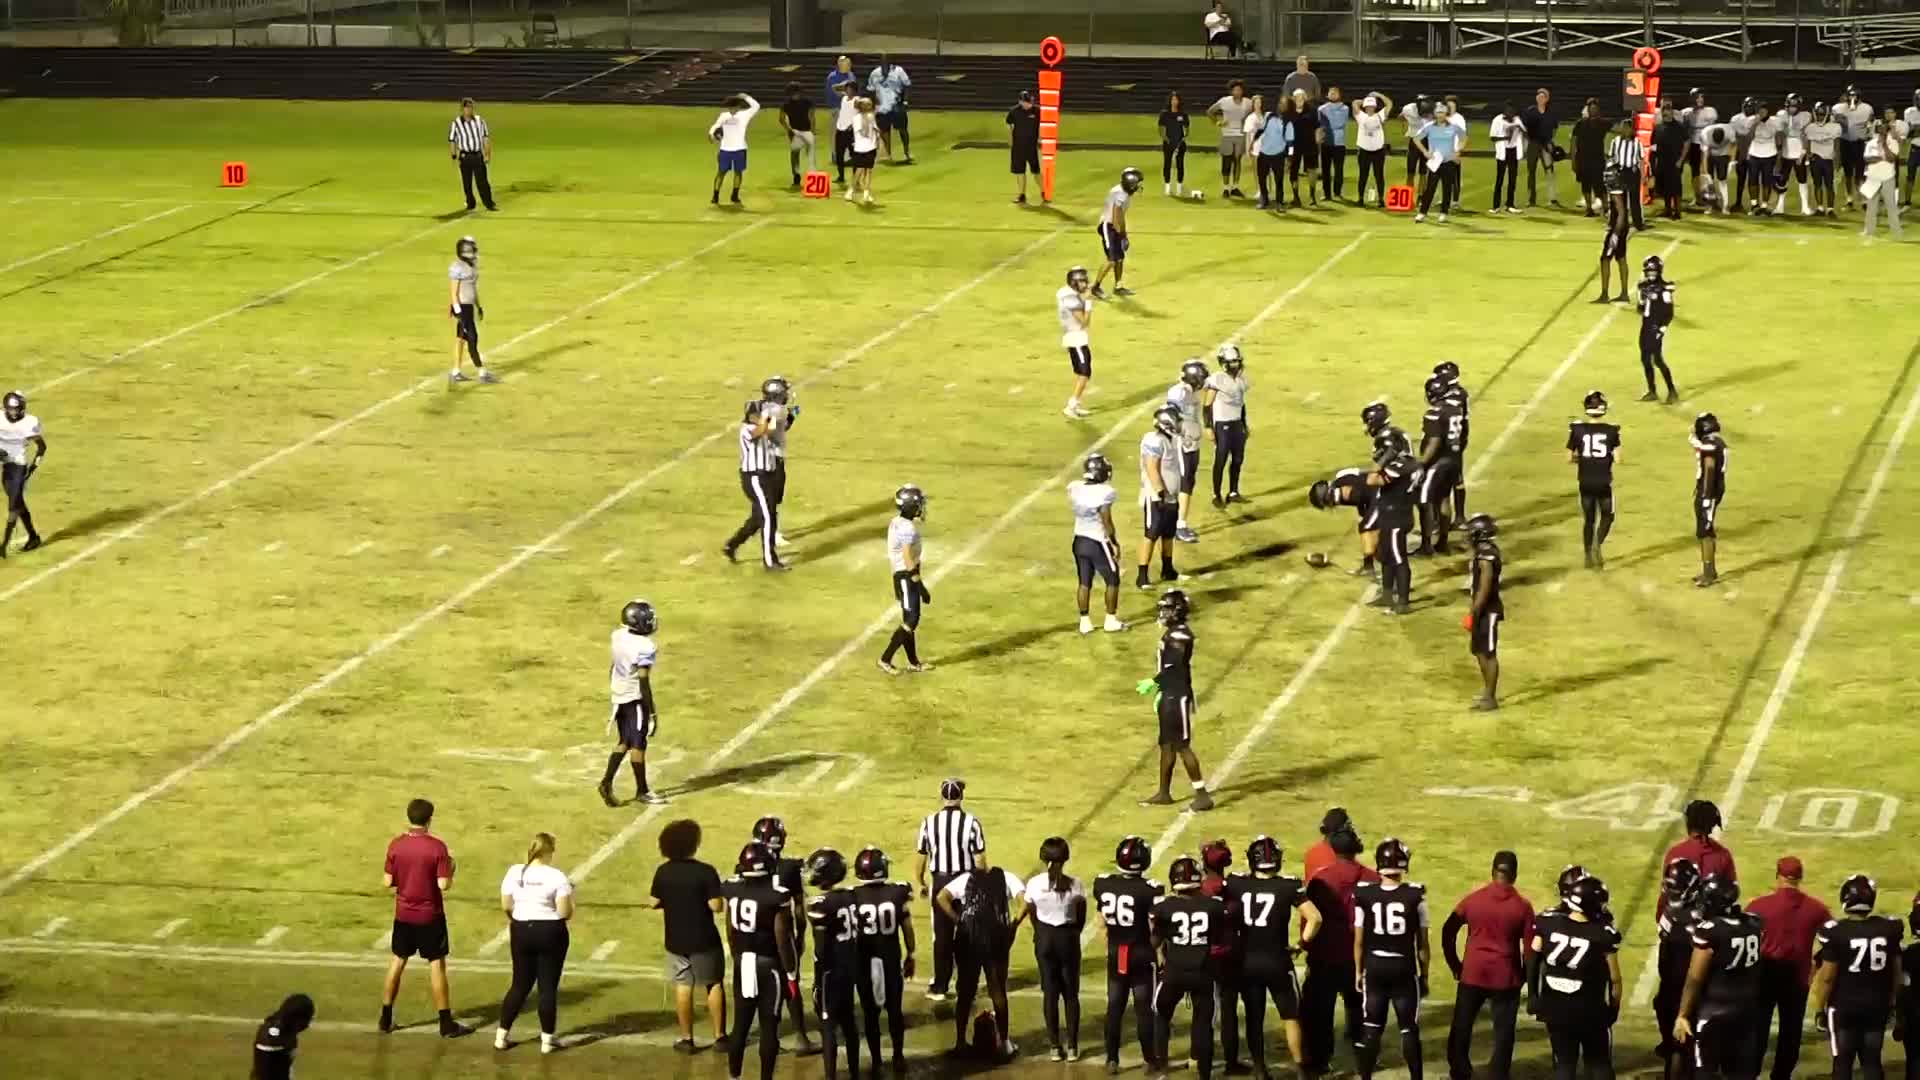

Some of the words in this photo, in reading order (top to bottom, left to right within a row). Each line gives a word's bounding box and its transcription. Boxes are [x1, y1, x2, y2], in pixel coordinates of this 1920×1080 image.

[227, 165, 243, 183] 10
[806, 175, 826, 193] 20
[1388, 188, 1410, 207] 30
[1582, 433, 1608, 458] 15
[1542, 781, 1901, 838] 40
[729, 897, 758, 933] 19
[859, 901, 896, 935] 30
[1100, 892, 1135, 927] 26
[1241, 892, 1275, 927] 17
[1371, 902, 1406, 935] 16
[1171, 911, 1209, 946] 32
[1546, 932, 1590, 969] 77
[1725, 934, 1759, 970] 78
[1849, 936, 1888, 973] 76
